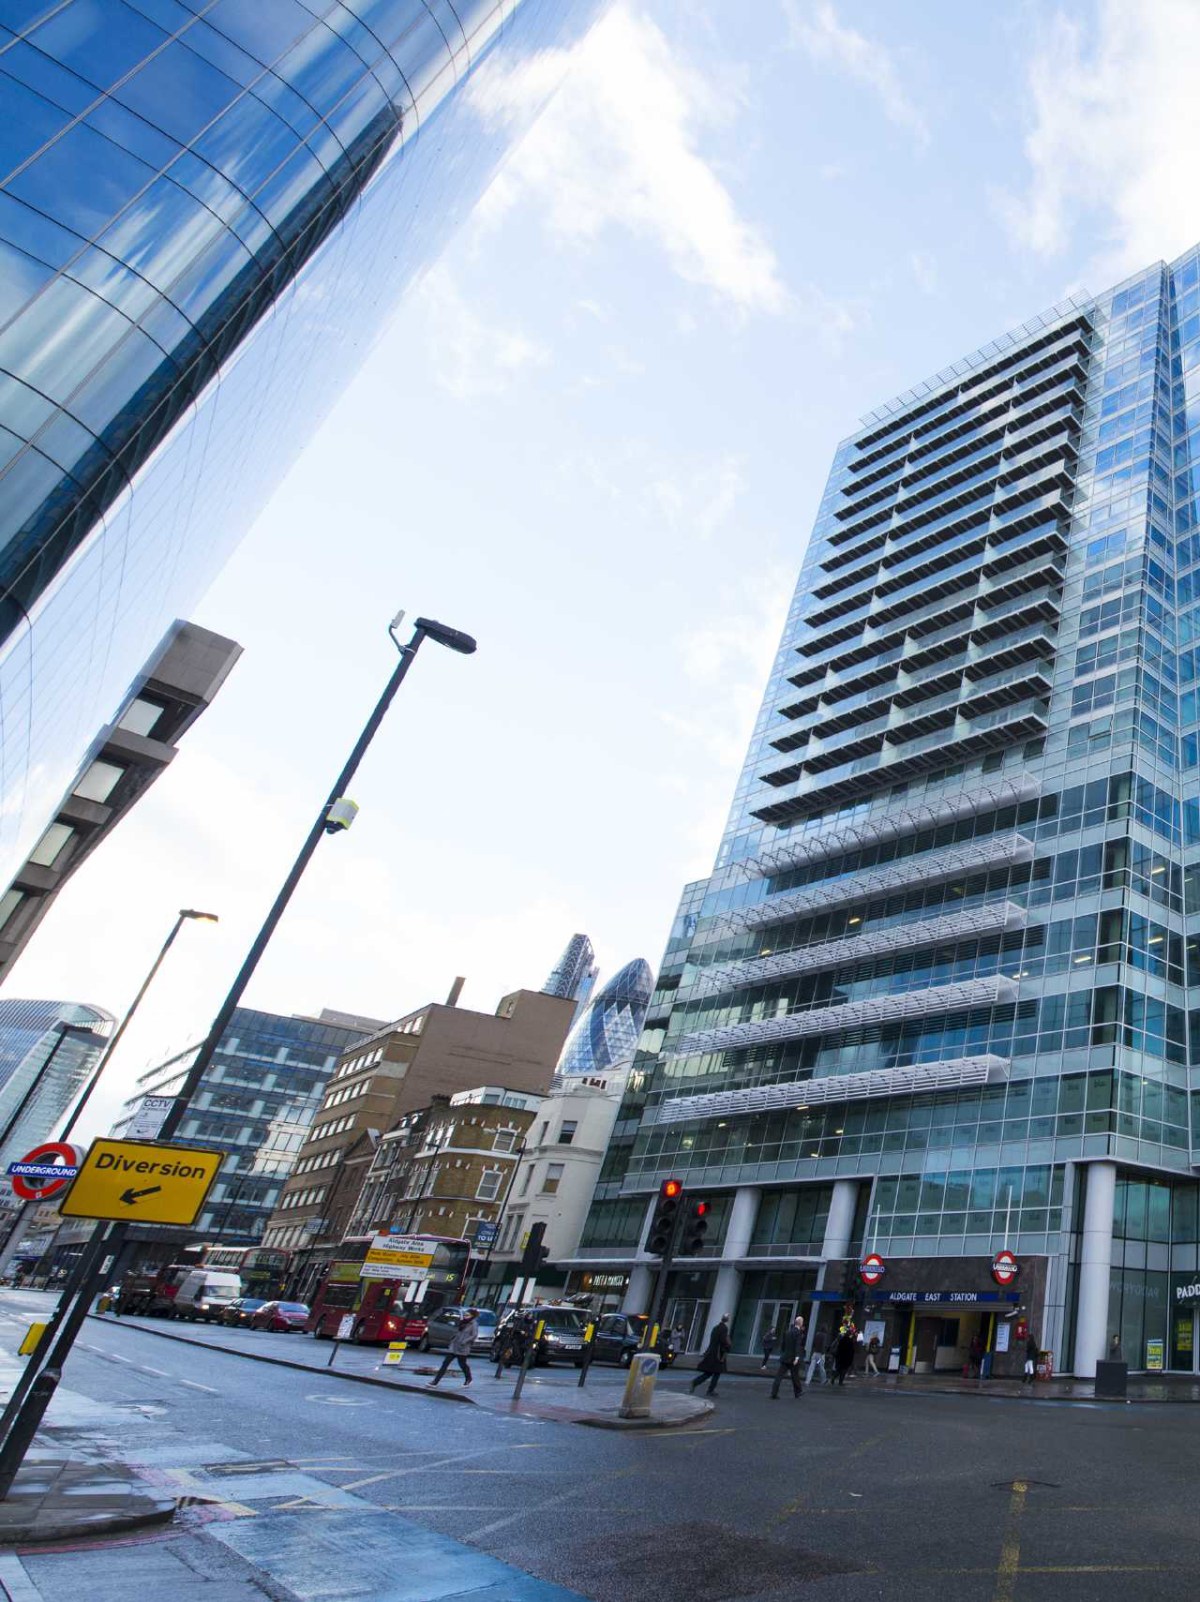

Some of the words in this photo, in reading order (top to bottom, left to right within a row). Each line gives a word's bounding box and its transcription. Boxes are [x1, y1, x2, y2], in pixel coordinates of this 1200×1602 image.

[143, 1099, 172, 1108] CCTV
[11, 1164, 78, 1177] UNDERGROUND
[95, 1153, 206, 1179] Diversion
[446, 1274, 456, 1282] 15
[889, 1292, 917, 1301] ALDGATE
[925, 1292, 941, 1301] EAST
[950, 1292, 978, 1301] STATION
